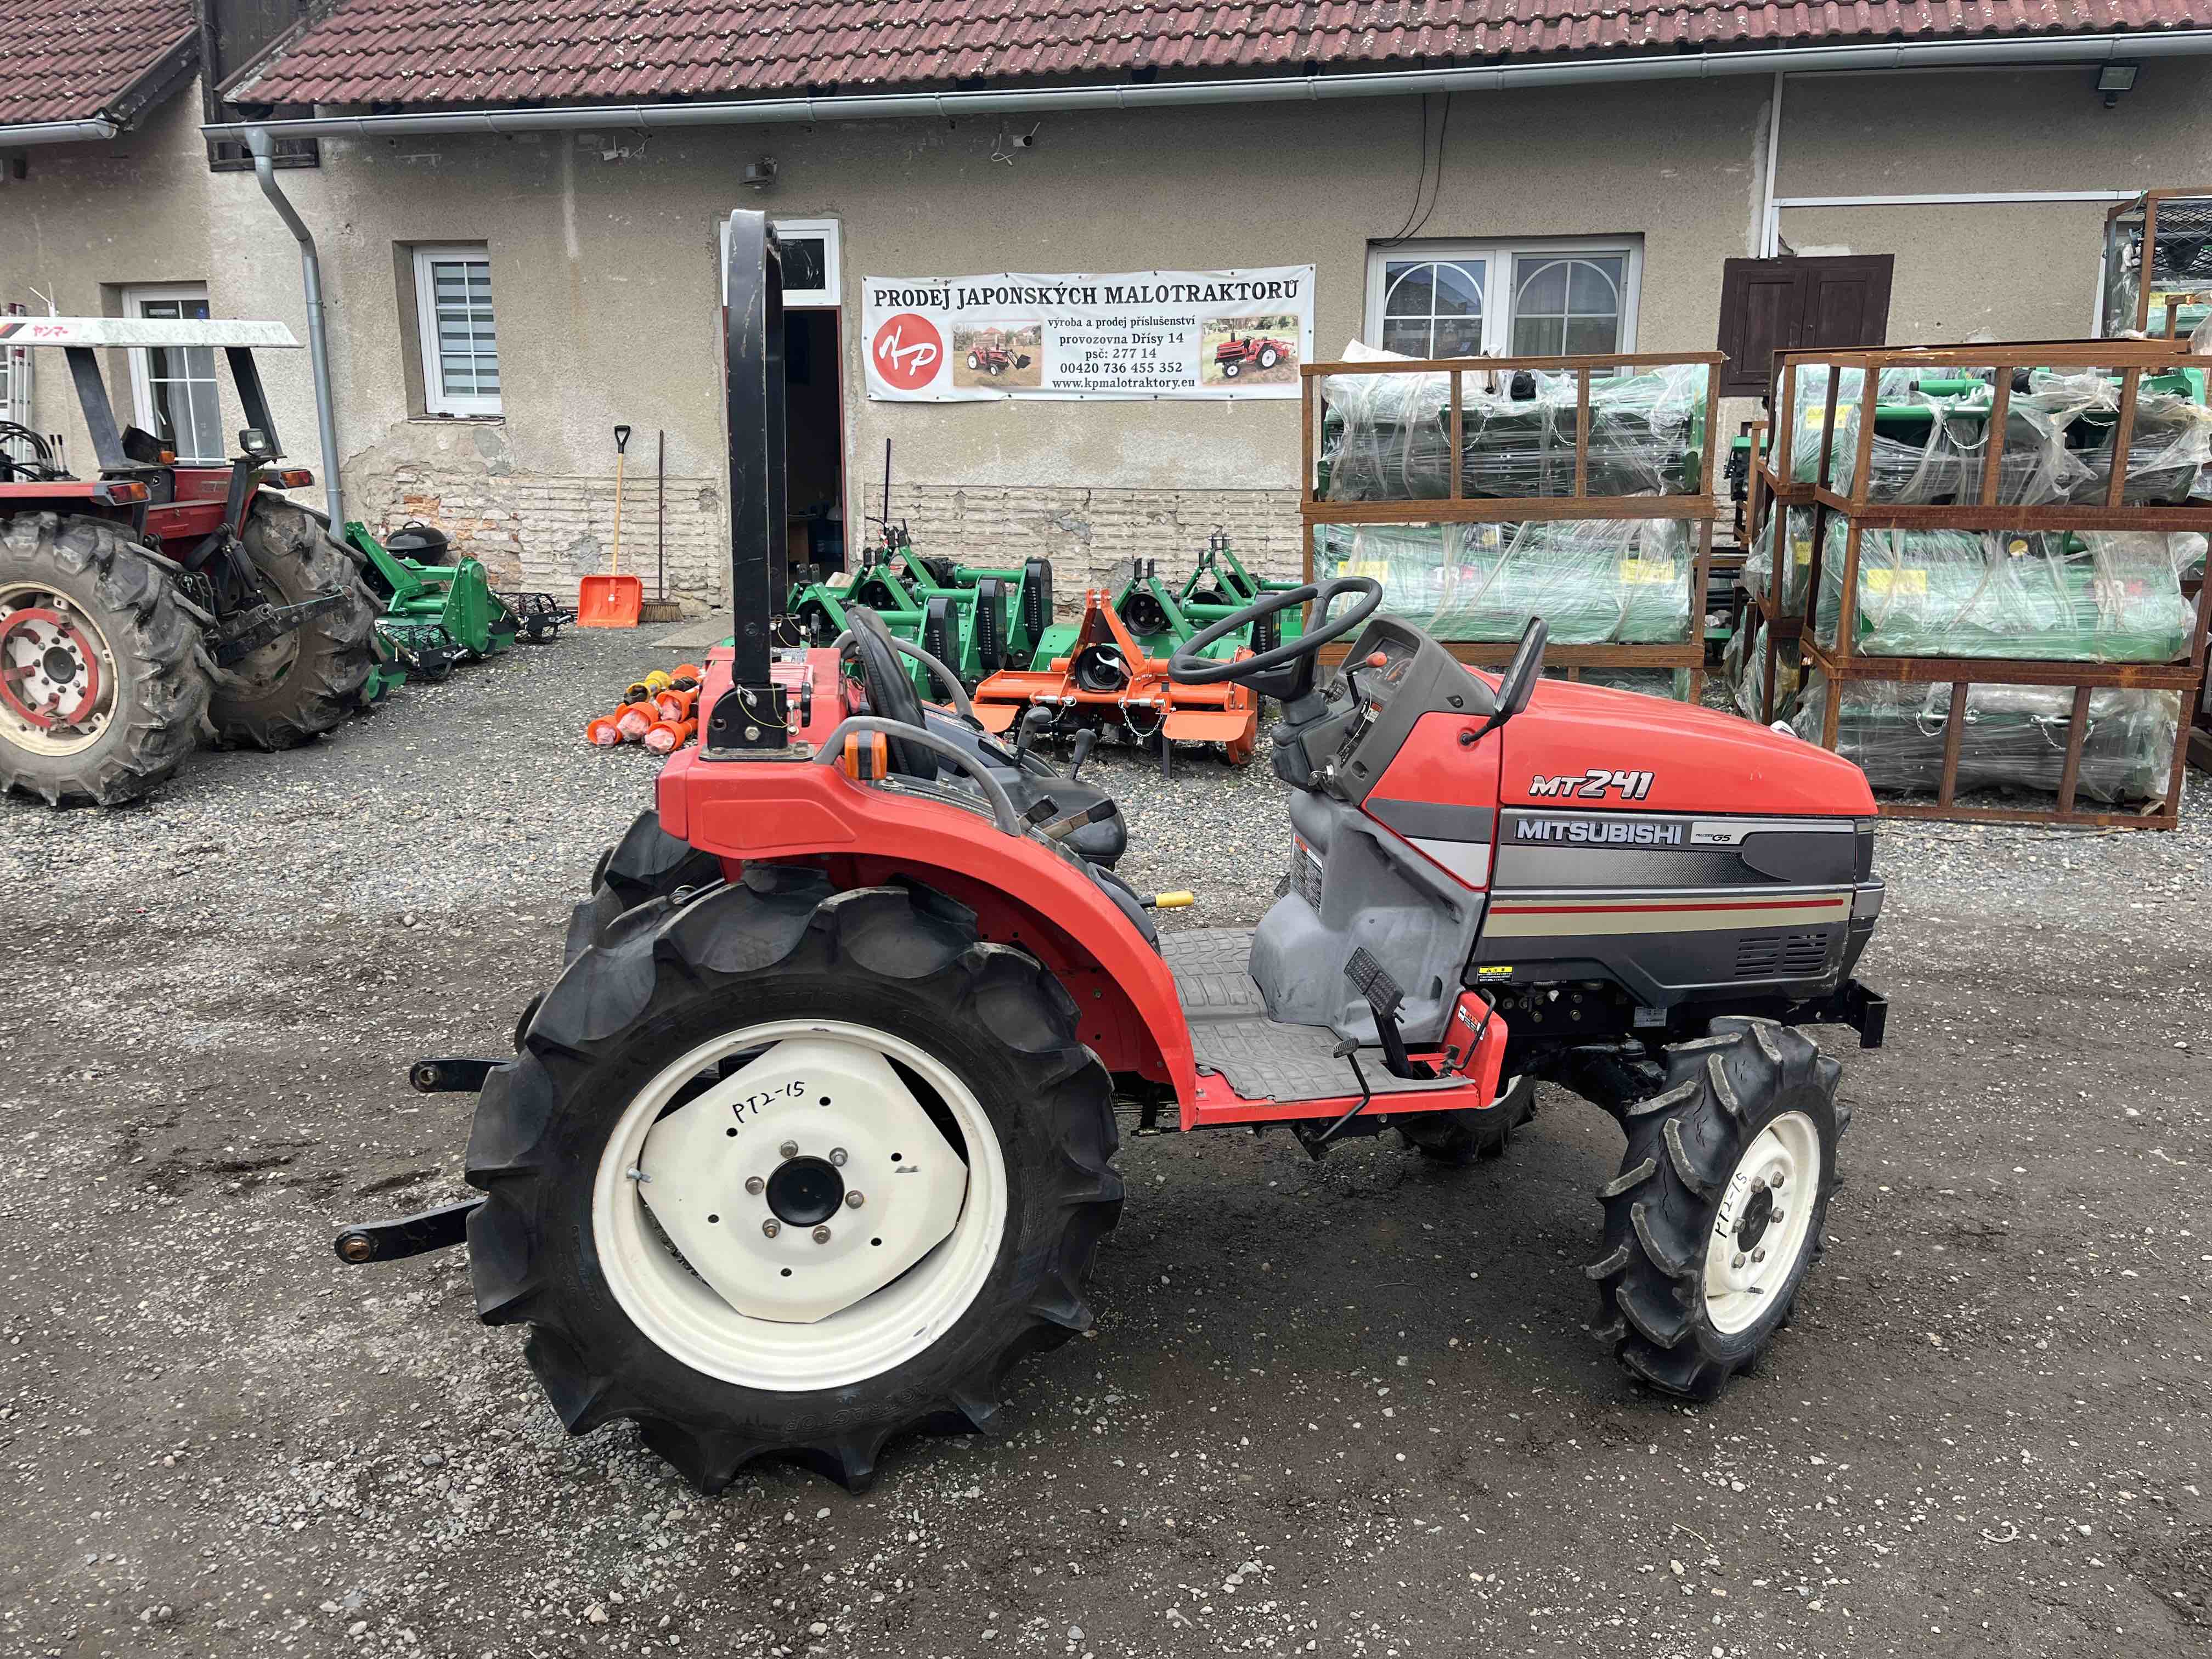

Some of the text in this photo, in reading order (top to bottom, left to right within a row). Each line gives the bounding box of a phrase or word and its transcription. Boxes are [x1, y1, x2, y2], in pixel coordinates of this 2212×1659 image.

[873, 279, 1300, 310] PRODEJ JAPONSKÝCH MALOTRAKTORŮ
[1048, 317, 1083, 329] výroba
[1096, 317, 1127, 329] prodej
[1131, 315, 1195, 328] příslušenství
[33, 325, 69, 337] ヤンマー
[1059, 332, 1184, 347] provozovna Dřísy 14
[1085, 348, 1157, 361] psč: 277 14
[1060, 362, 1183, 374] 00420 736 455 352
[1052, 377, 1195, 390] www.kpmalotraktory.eu
[1528, 769, 1655, 800] MT241
[1515, 819, 1684, 845] MITSUBISHI
[732, 1081, 805, 1123] PT2-15
